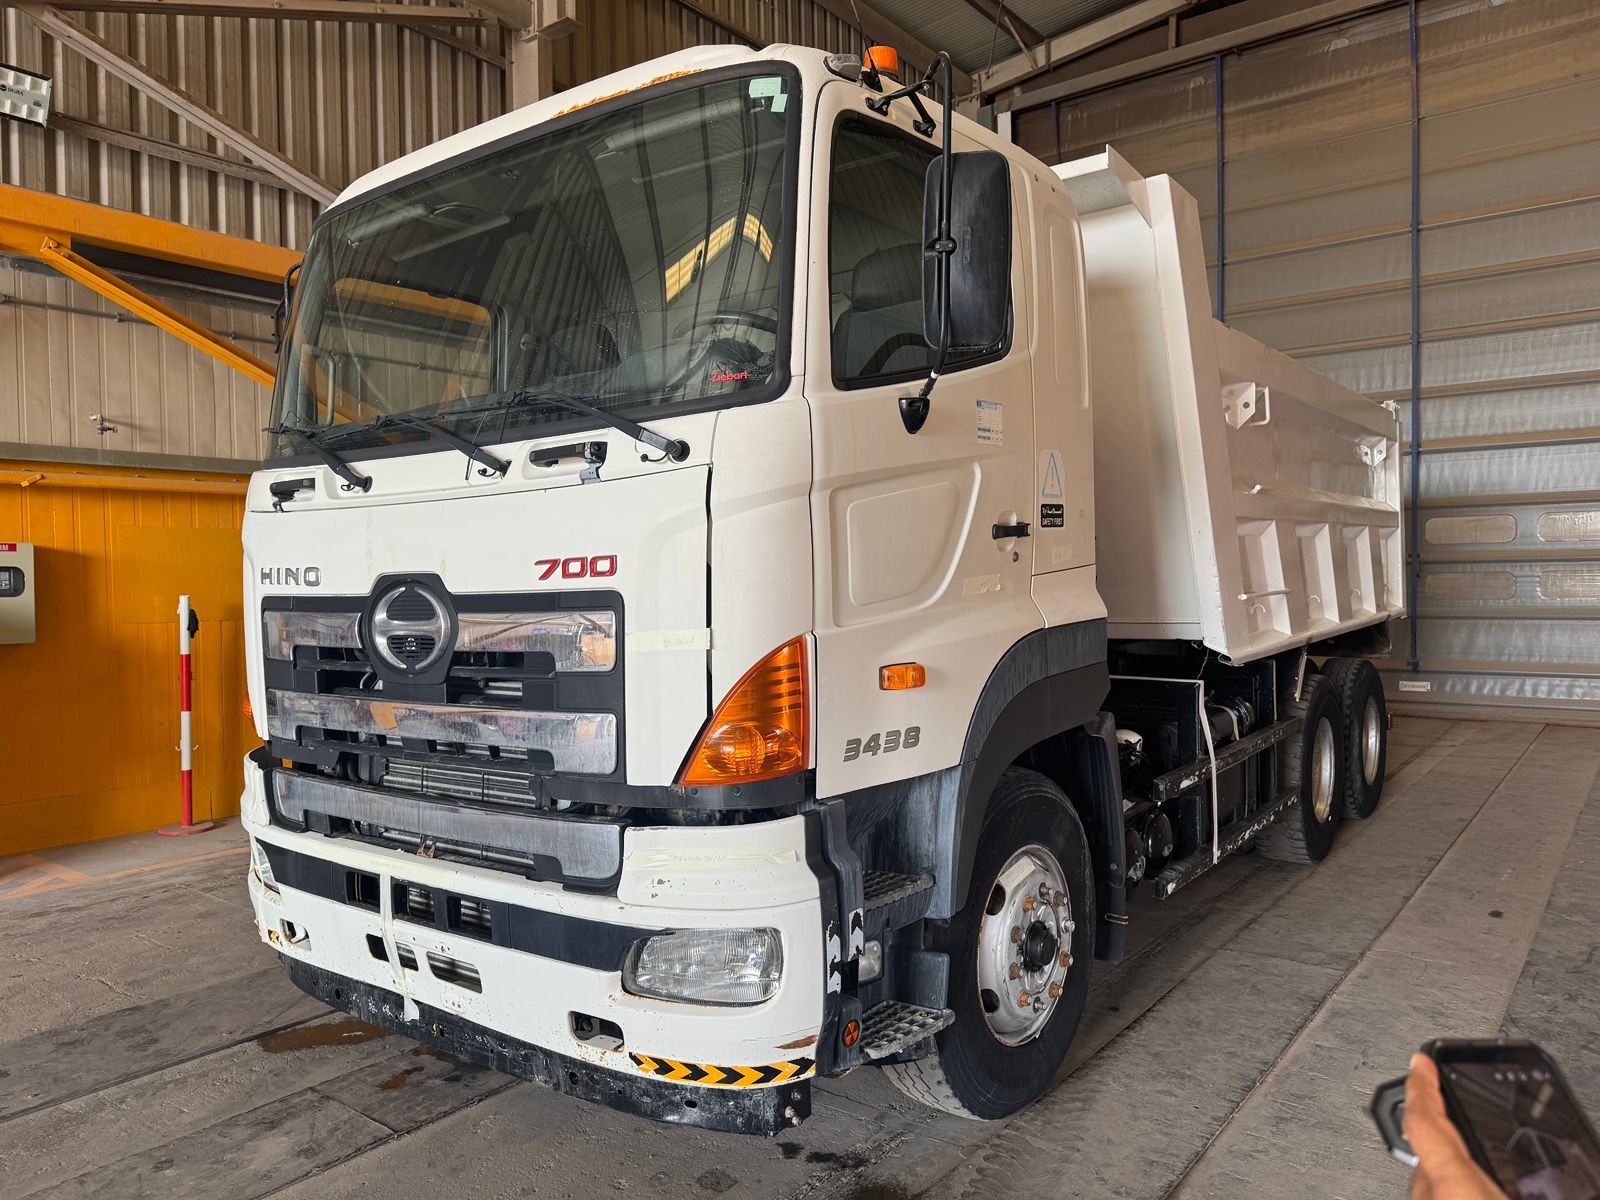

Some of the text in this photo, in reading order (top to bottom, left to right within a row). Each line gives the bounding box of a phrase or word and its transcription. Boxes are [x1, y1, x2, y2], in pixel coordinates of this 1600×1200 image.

[260, 566, 321, 587] HINO
[534, 555, 617, 580] 700
[843, 726, 921, 762] 3438
